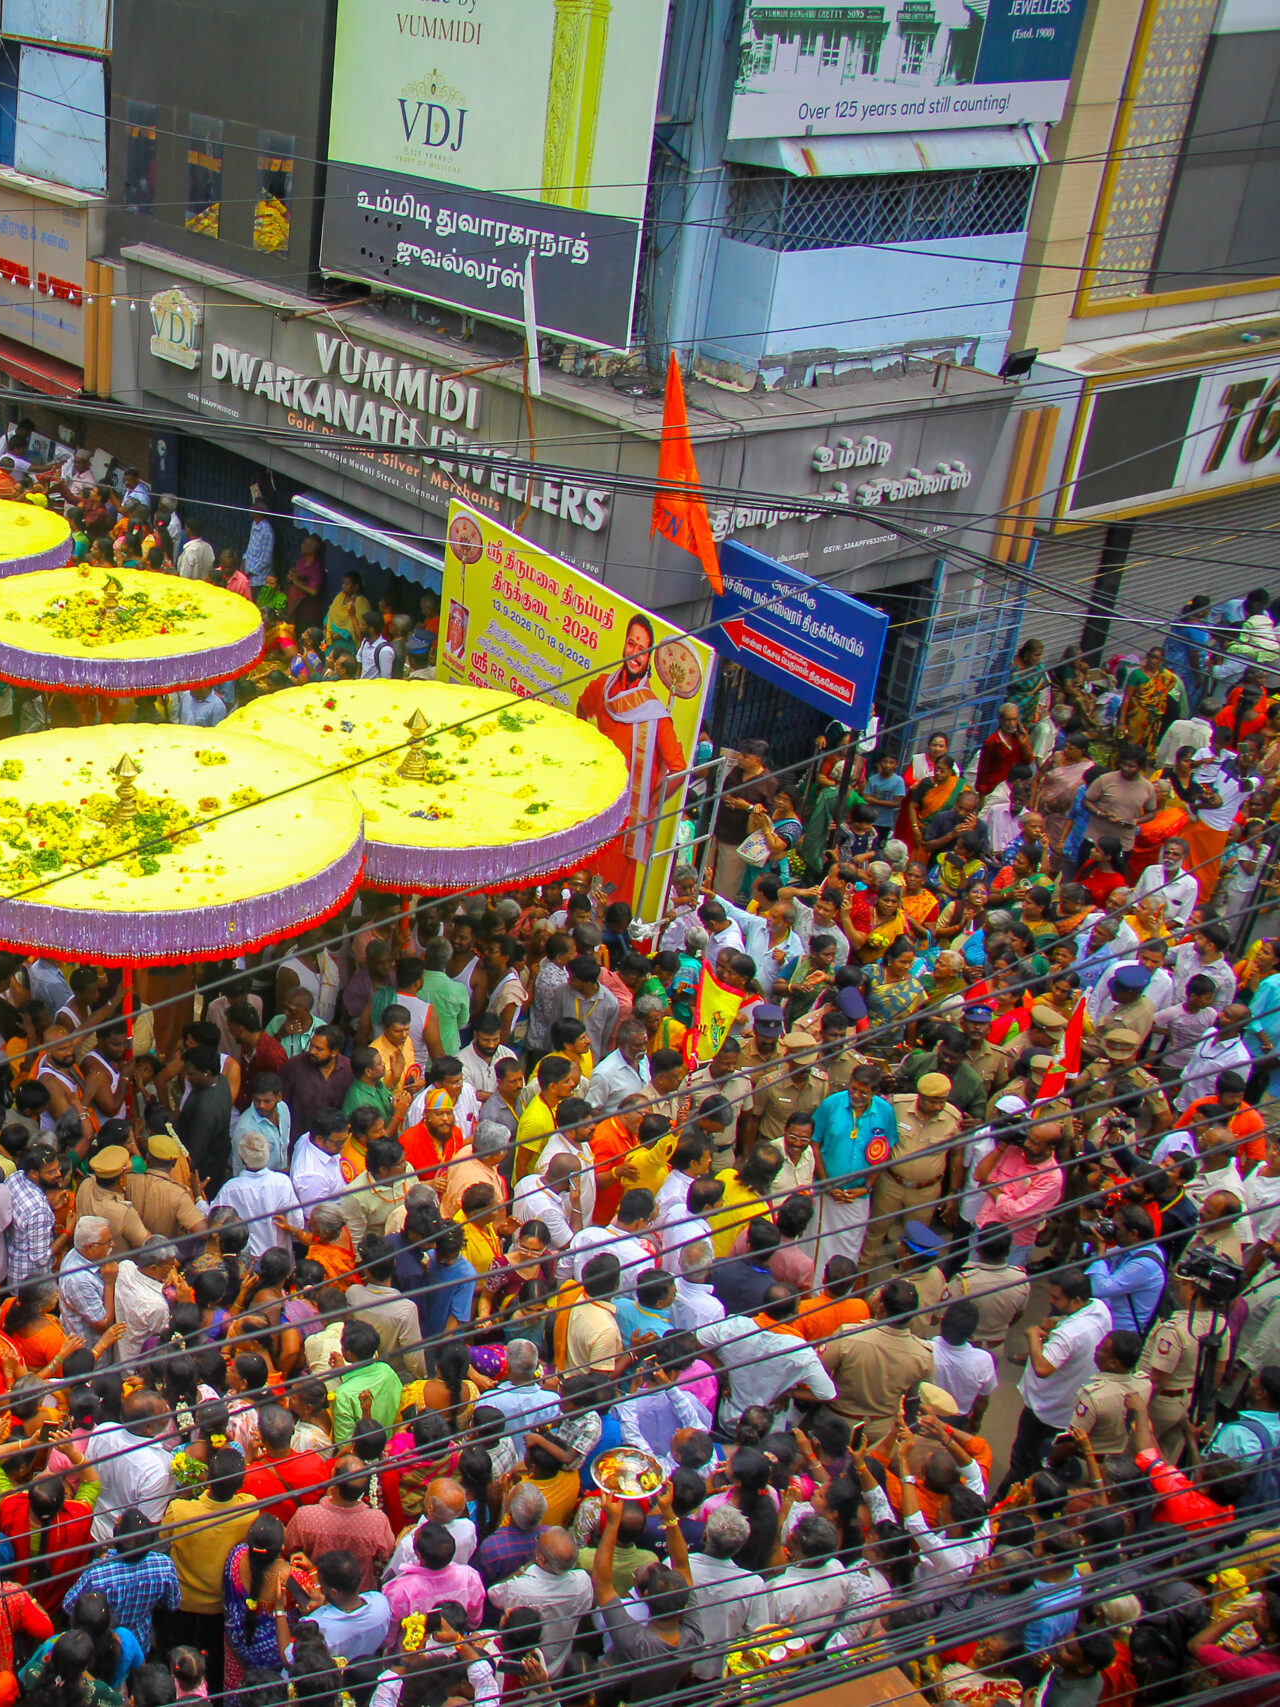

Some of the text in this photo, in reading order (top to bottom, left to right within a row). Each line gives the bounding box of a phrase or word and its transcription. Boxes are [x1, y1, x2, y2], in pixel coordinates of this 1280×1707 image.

[396, 13, 482, 45] VUMMIDI
[846, 9, 865, 19] SONS
[1007, 0, 1072, 16] JEWELLERS
[1011, 27, 1055, 42] (Estd. 1900)
[397, 98, 469, 152] VDJ
[798, 93, 1011, 123] Over 125 years and still counting!
[357, 188, 590, 265] உம்மிடி துவாரகாநாத்
[396, 240, 527, 292] ஜுவல்லர்ஸ்
[151, 307, 196, 350] VDJ
[315, 332, 483, 431] VUMMIDI
[210, 343, 612, 532] DWARKANATH JEWELLERS
[812, 434, 894, 473] உம்மிடி
[287, 411, 315, 433] Gold
[430, 472, 502, 512] Merchants
[348, 458, 376, 476] Mudali
[376, 470, 401, 487] Street
[405, 481, 440, 503] Chennai
[491, 570, 553, 623] திருக்குடை
[561, 614, 599, 650] 2026
[504, 549, 560, 597] திருமலை
[559, 583, 615, 630] திருப்பதி
[492, 599, 591, 671] 13.9.2026 TO 18.9.2026
[801, 614, 865, 658] திருக்கோயில்
[489, 662, 507, 686] RR.
